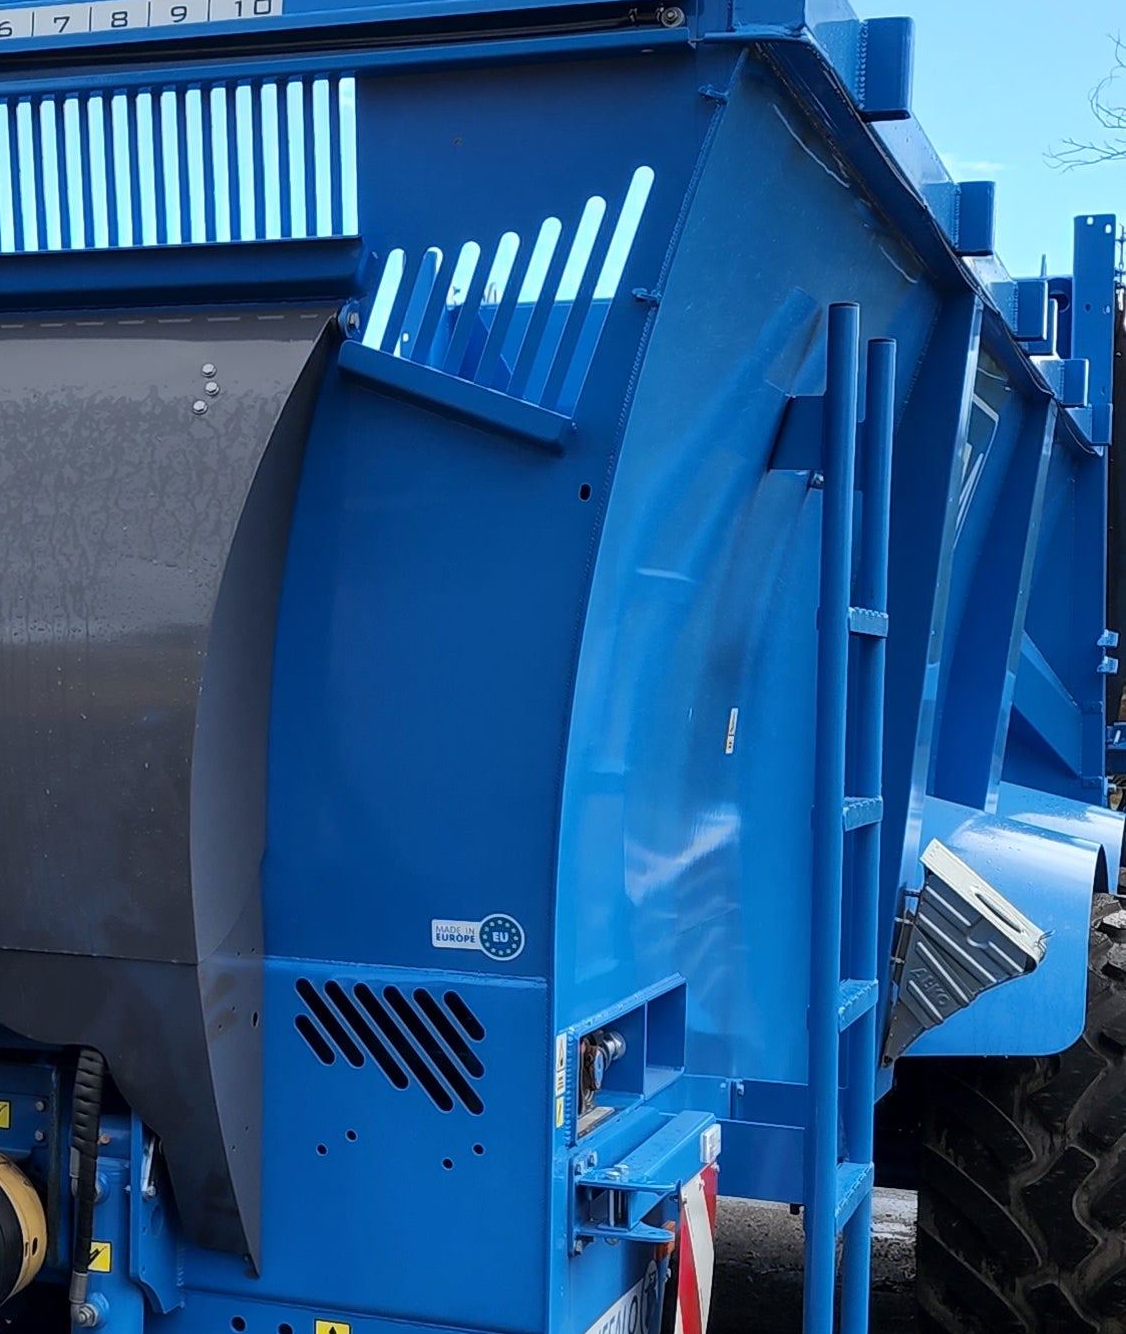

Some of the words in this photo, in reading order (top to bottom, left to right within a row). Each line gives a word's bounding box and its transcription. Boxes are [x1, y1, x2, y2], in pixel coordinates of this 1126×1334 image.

[53, 16, 70, 33] 7
[111, 11, 128, 28] 8
[170, 5, 187, 23] 9
[435, 925, 461, 934] MADE
[465, 927, 475, 935] IN
[436, 933, 476, 943] EUROPE
[492, 931, 509, 943] EU
